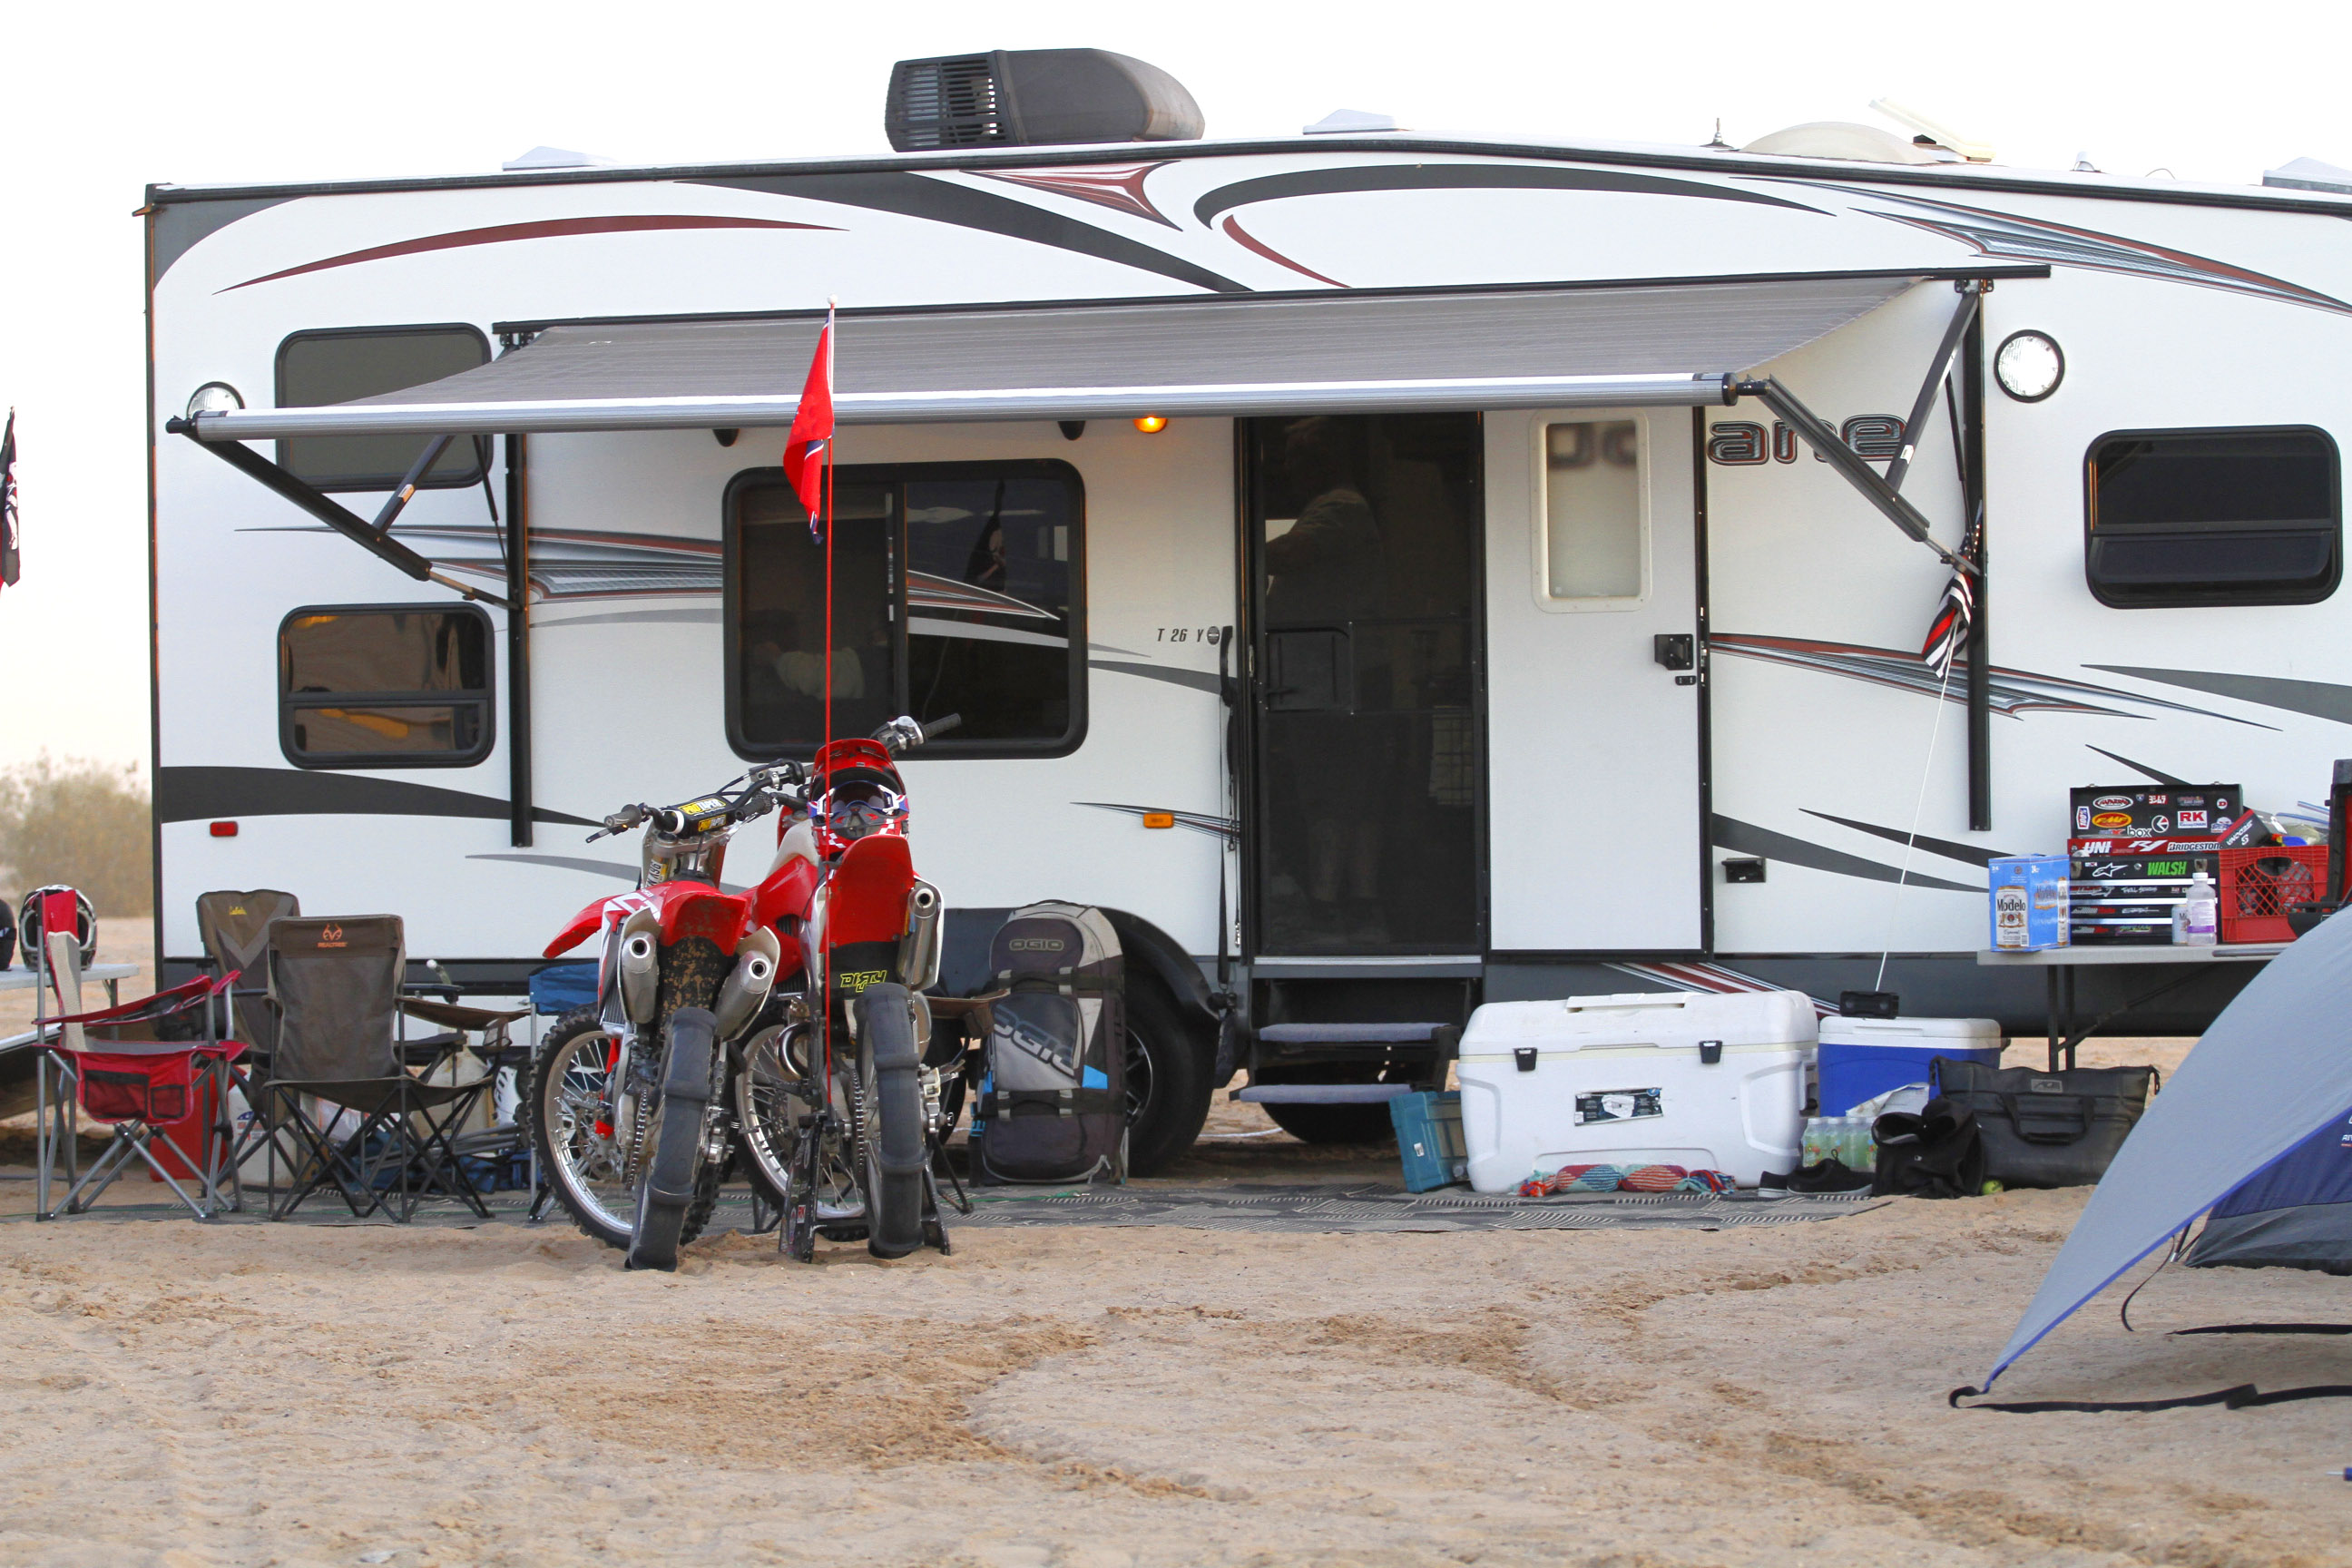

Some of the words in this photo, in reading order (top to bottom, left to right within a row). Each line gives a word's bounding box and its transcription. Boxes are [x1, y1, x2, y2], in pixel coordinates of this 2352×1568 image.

[1158, 628, 1165, 642] T
[1171, 628, 1188, 642] 26
[2180, 812, 2204, 822] RK
[2127, 825, 2152, 838] box
[2082, 841, 2112, 854] UNI
[2168, 842, 2222, 851] BRIDGESTON
[2148, 861, 2187, 876] WALSH
[1997, 898, 2026, 911] Modelo
[1009, 938, 1064, 952] OGIO
